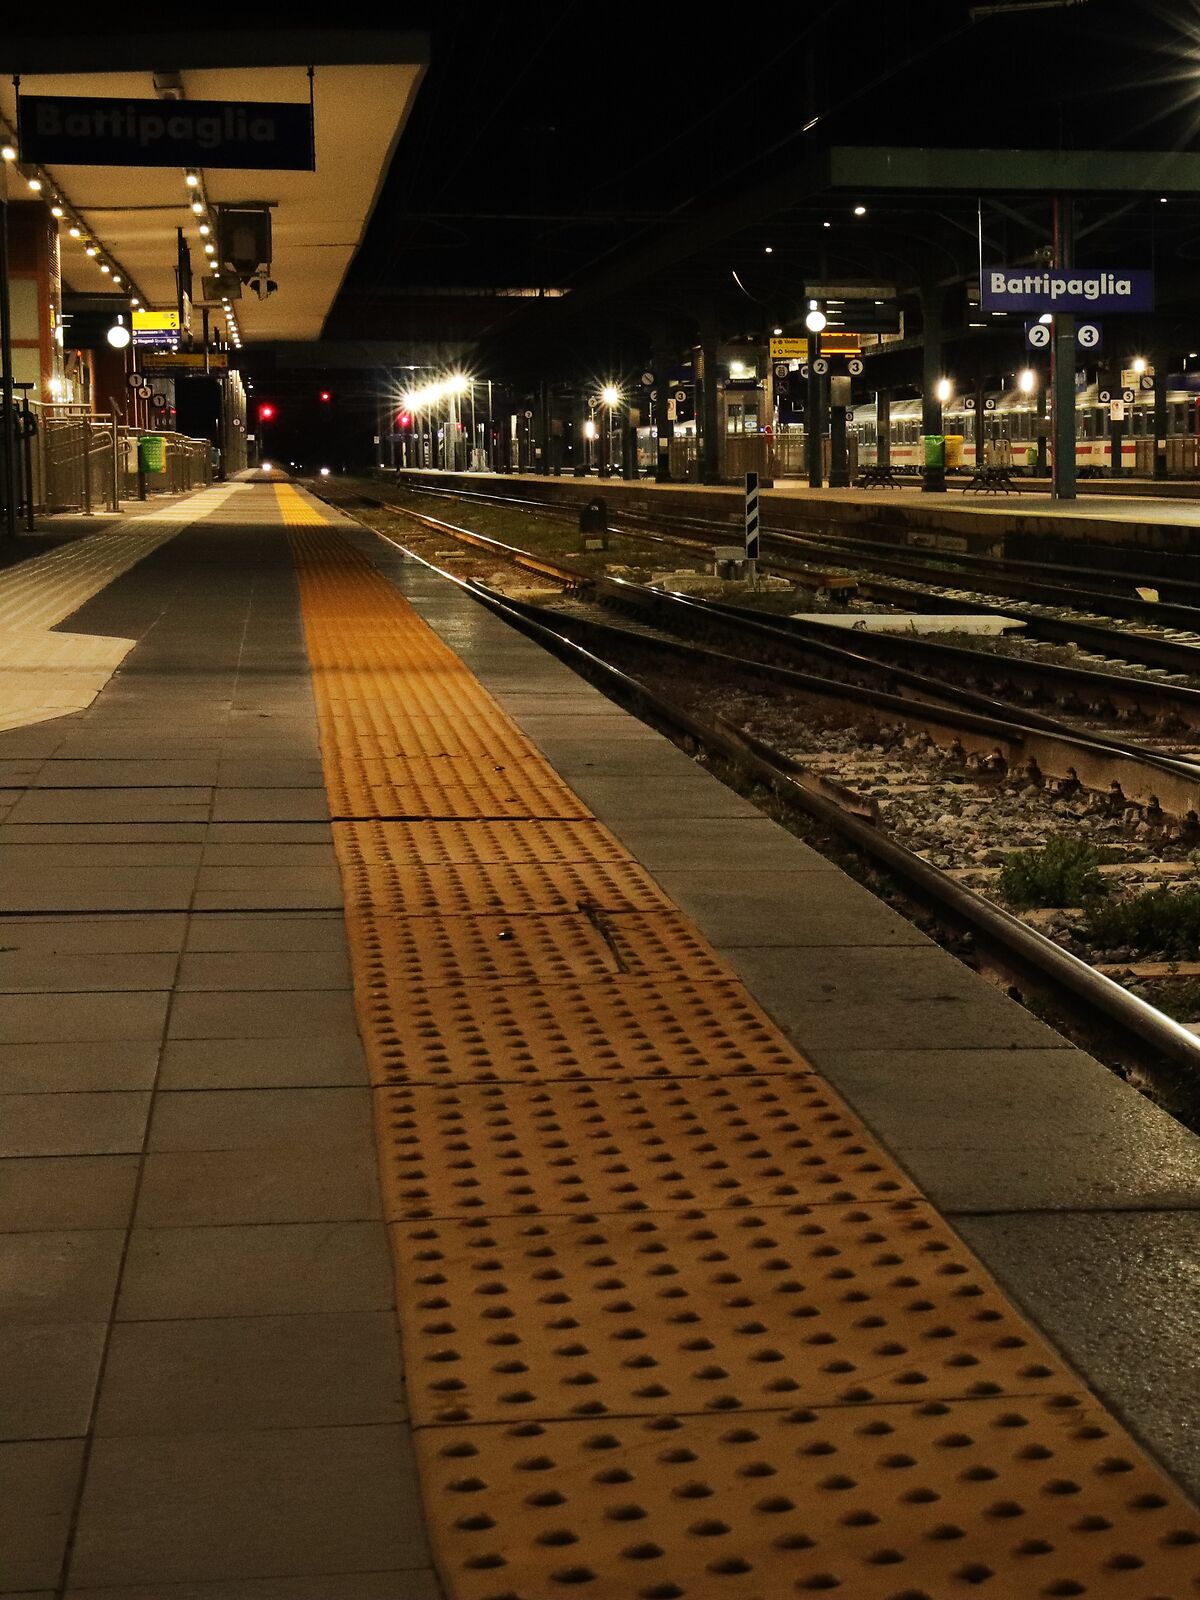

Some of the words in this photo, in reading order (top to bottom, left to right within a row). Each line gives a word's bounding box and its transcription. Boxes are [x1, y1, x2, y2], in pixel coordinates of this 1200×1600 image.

[34, 103, 275, 149] Battipaglia
[990, 272, 1131, 300] Battipaglia
[1034, 330, 1044, 343] 2
[1083, 329, 1094, 343] 3
[816, 362, 825, 372] 2
[852, 362, 860, 372] 3
[677, 392, 684, 400] 3
[1101, 392, 1108, 400] 4
[1126, 392, 1132, 400] 5
[967, 400, 973, 408] 4
[987, 400, 994, 408] 5
